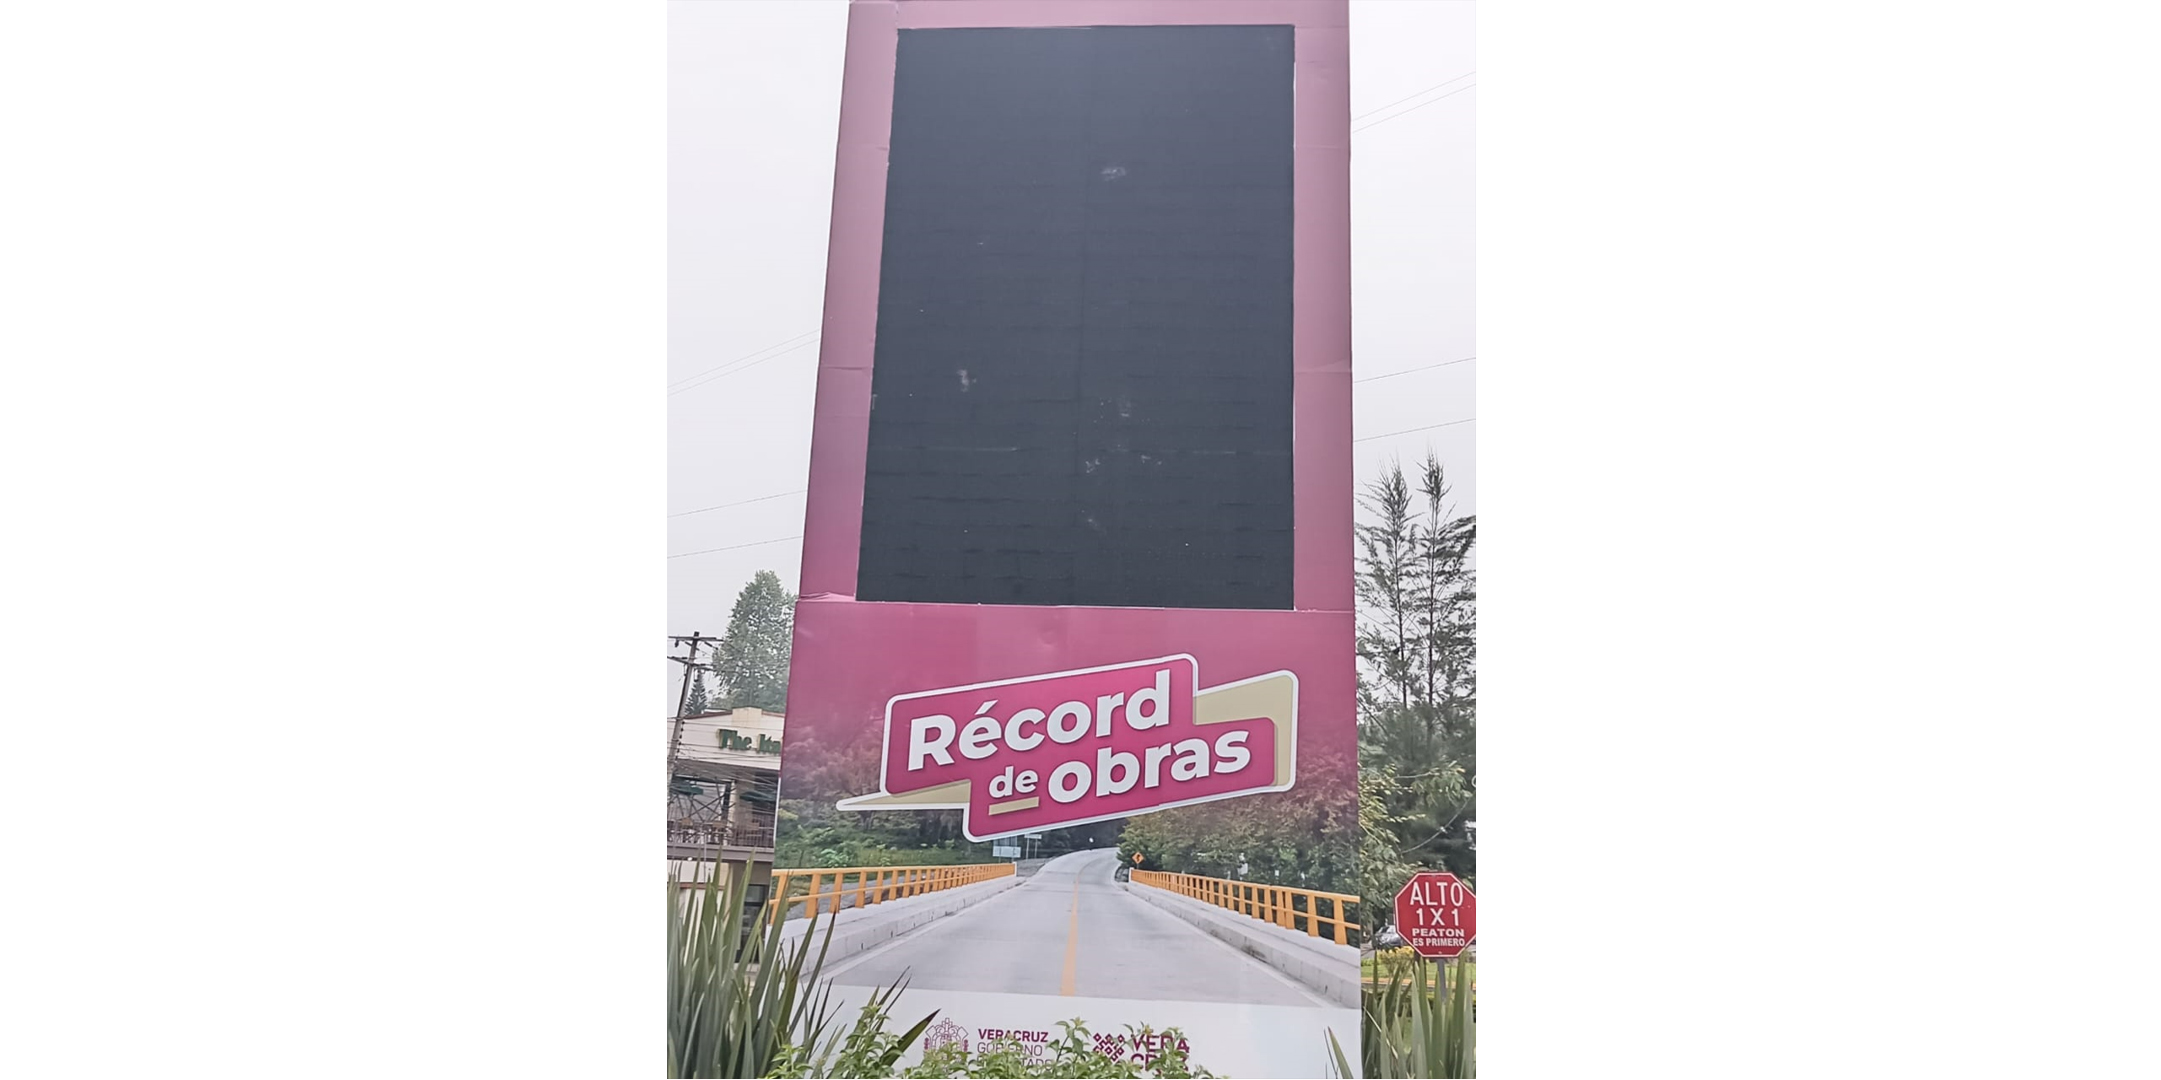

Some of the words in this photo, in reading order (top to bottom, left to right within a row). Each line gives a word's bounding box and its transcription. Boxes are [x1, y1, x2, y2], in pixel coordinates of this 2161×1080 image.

[908, 669, 1170, 771] Récord
[718, 728, 752, 750] The
[988, 766, 1038, 798] de
[1048, 730, 1251, 803] obras
[1410, 881, 1463, 907] ALTO
[1412, 927, 1465, 938] PEATON
[1412, 937, 1424, 947] ES
[1425, 937, 1465, 947] PRIMERO
[978, 1028, 1049, 1043] VERACRUZ
[977, 1042, 1043, 1057] GOBENO
